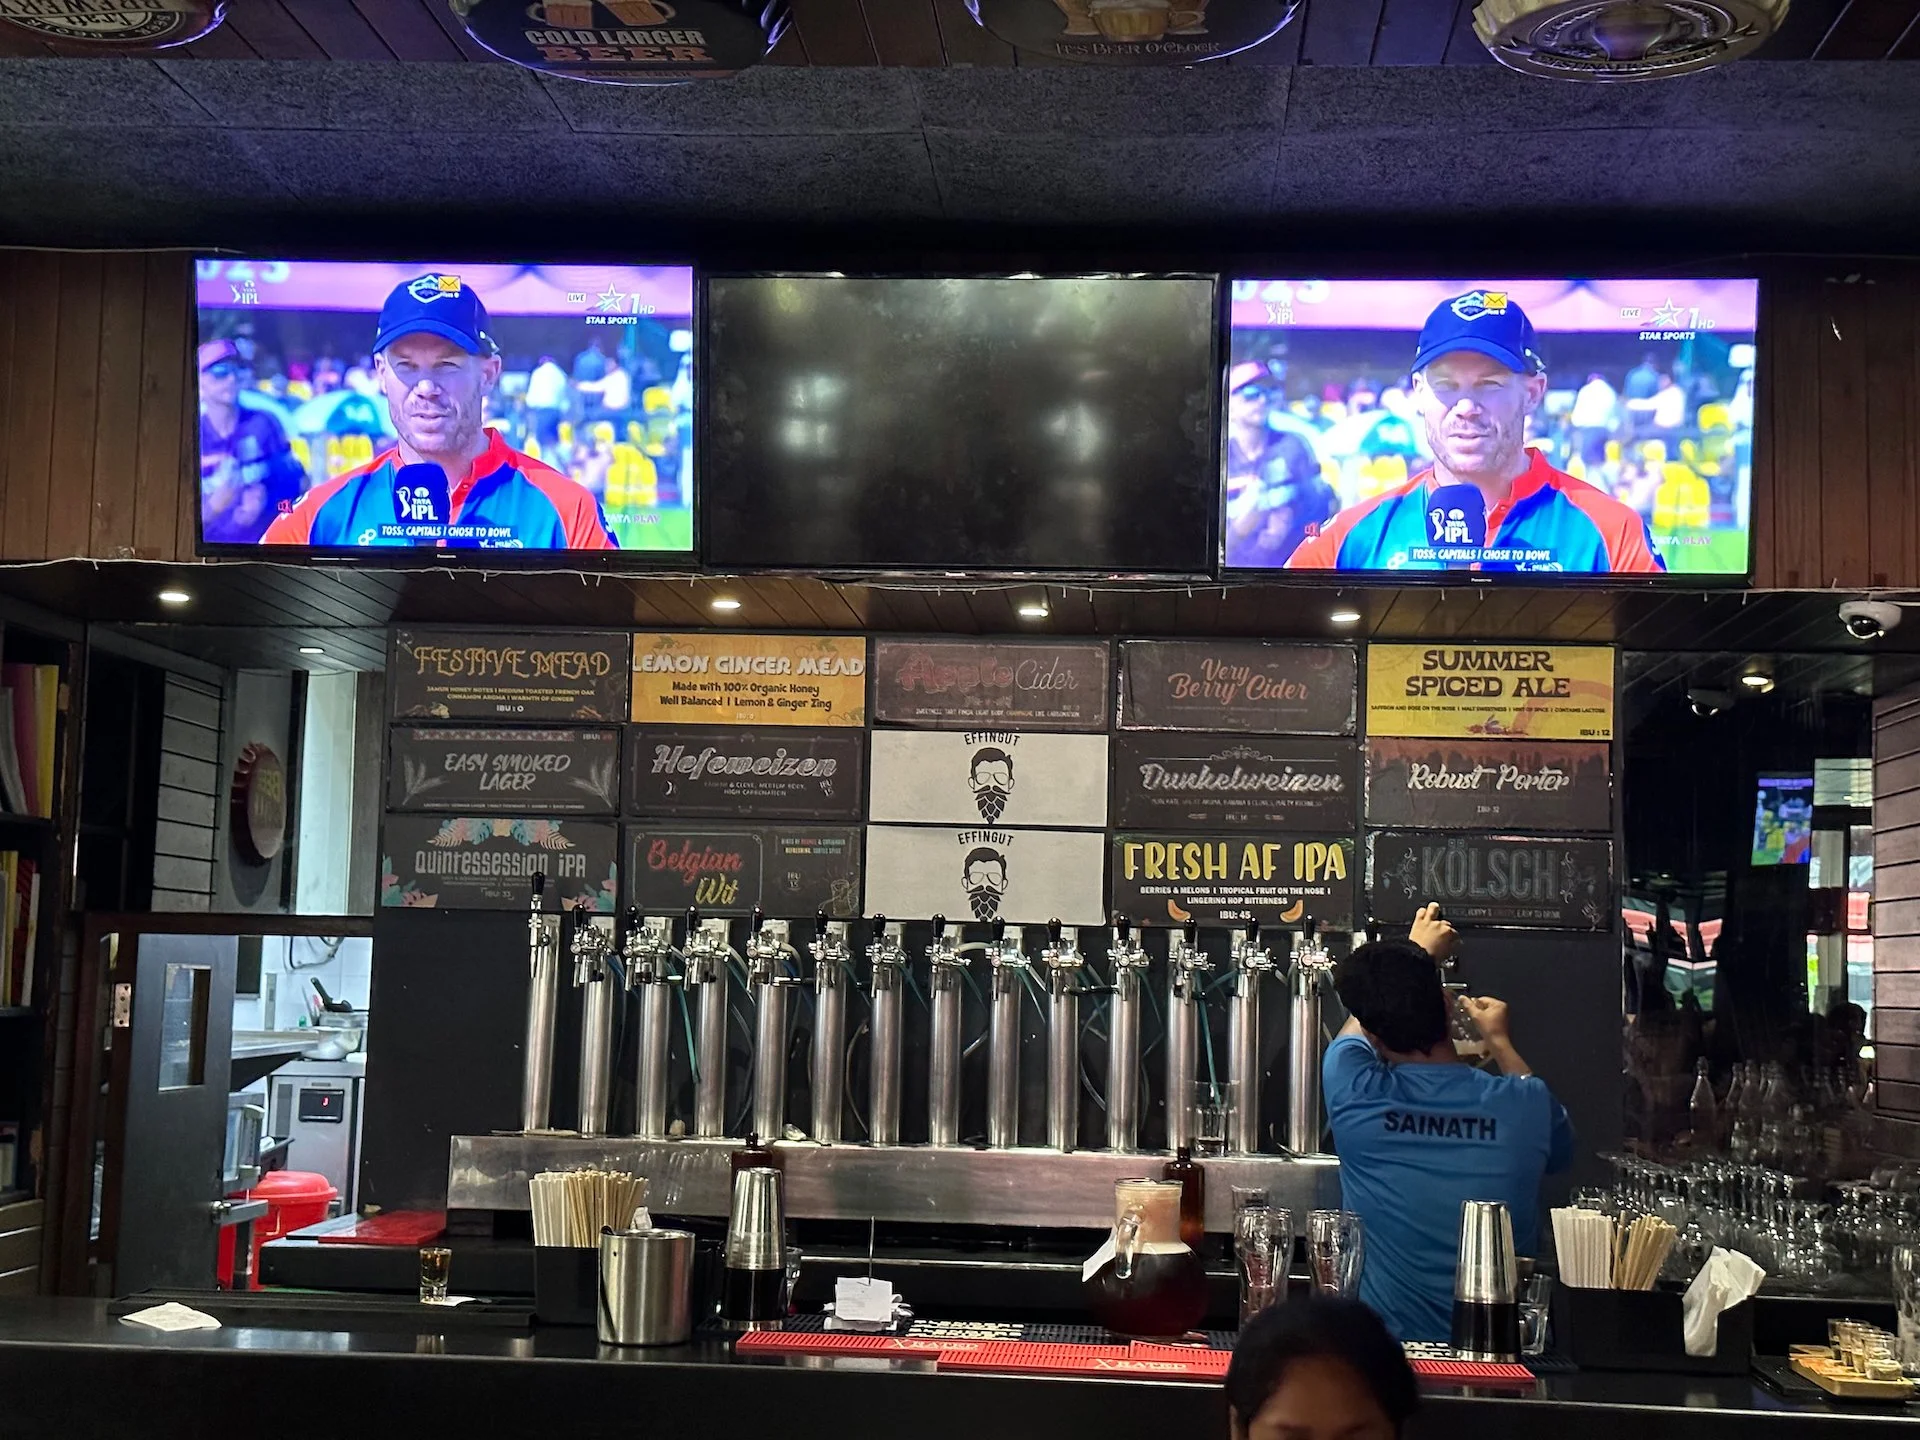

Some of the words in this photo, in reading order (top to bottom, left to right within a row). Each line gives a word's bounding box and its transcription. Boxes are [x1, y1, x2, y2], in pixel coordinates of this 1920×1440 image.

[524, 30, 597, 45] COLD
[600, 30, 706, 46] LARGER
[536, 46, 714, 62] BEER
[242, 293, 260, 304] IPL
[640, 306, 656, 314] HD
[585, 316, 606, 324] STAR
[607, 316, 638, 324] SPORTS
[1700, 320, 1715, 329] HD
[1639, 332, 1661, 341] STAR
[1662, 332, 1695, 341] SPORTS
[411, 504, 438, 521] IPL
[382, 526, 405, 537] TOSS:
[406, 527, 442, 537] CAPITALS
[448, 528, 474, 538] CHOSE
[475, 528, 487, 538] TO
[488, 528, 512, 538] BOWL
[1445, 527, 1473, 543] IPL
[1412, 549, 1436, 560] TOSS:
[1437, 549, 1475, 560] CAPITALS
[1482, 550, 1509, 561] CHOSE
[1512, 551, 1523, 560] TO
[1525, 551, 1551, 561] BOWL
[414, 647, 530, 678] FESTIVE
[530, 651, 611, 679] MEAD
[632, 654, 710, 674] LEMON
[715, 656, 791, 675] GINGER
[796, 657, 865, 677] MEAD
[1423, 650, 1553, 672] SUMMER
[896, 650, 1015, 694] Apple
[1015, 656, 1079, 690] Cider
[1201, 658, 1251, 685] Very
[672, 681, 697, 691] Made
[700, 681, 721, 692] with
[723, 682, 748, 692] 100%
[750, 683, 787, 696] Organic
[789, 684, 820, 697] Honey
[1168, 673, 1238, 705] Berry
[1246, 674, 1309, 700] Cider
[1405, 676, 1502, 697] SPICED
[1512, 677, 1570, 698] ALE
[496, 704, 511, 712] IBU
[660, 696, 679, 705] Well
[681, 696, 723, 706] Balanced
[734, 697, 766, 707] Lemon
[767, 698, 775, 707] &
[777, 698, 808, 711] Ginger
[810, 699, 832, 711] Zing
[964, 732, 1021, 747] EFFINGUT
[444, 753, 488, 771] EASY
[493, 754, 571, 773] SMOKED
[651, 744, 838, 781] Hefeweizen
[479, 772, 537, 791] LAGER
[1139, 763, 1345, 792] Dunkelweizen
[1407, 762, 1496, 790] Robust
[1495, 763, 1570, 791] Porter
[958, 830, 1014, 846] EFFINGUT
[647, 839, 744, 885] Belgian
[1124, 842, 1227, 880] FRESH
[1239, 842, 1281, 880] AF
[1293, 842, 1347, 882] IPA
[1422, 838, 1559, 899] KÖLSCH
[695, 872, 739, 905] Wit
[1219, 887, 1255, 895] TROPICAL
[1256, 887, 1276, 895] FRUIT
[1219, 911, 1238, 920] IBU:
[1239, 911, 1251, 920] 45
[1384, 1110, 1497, 1140] SAINATH
